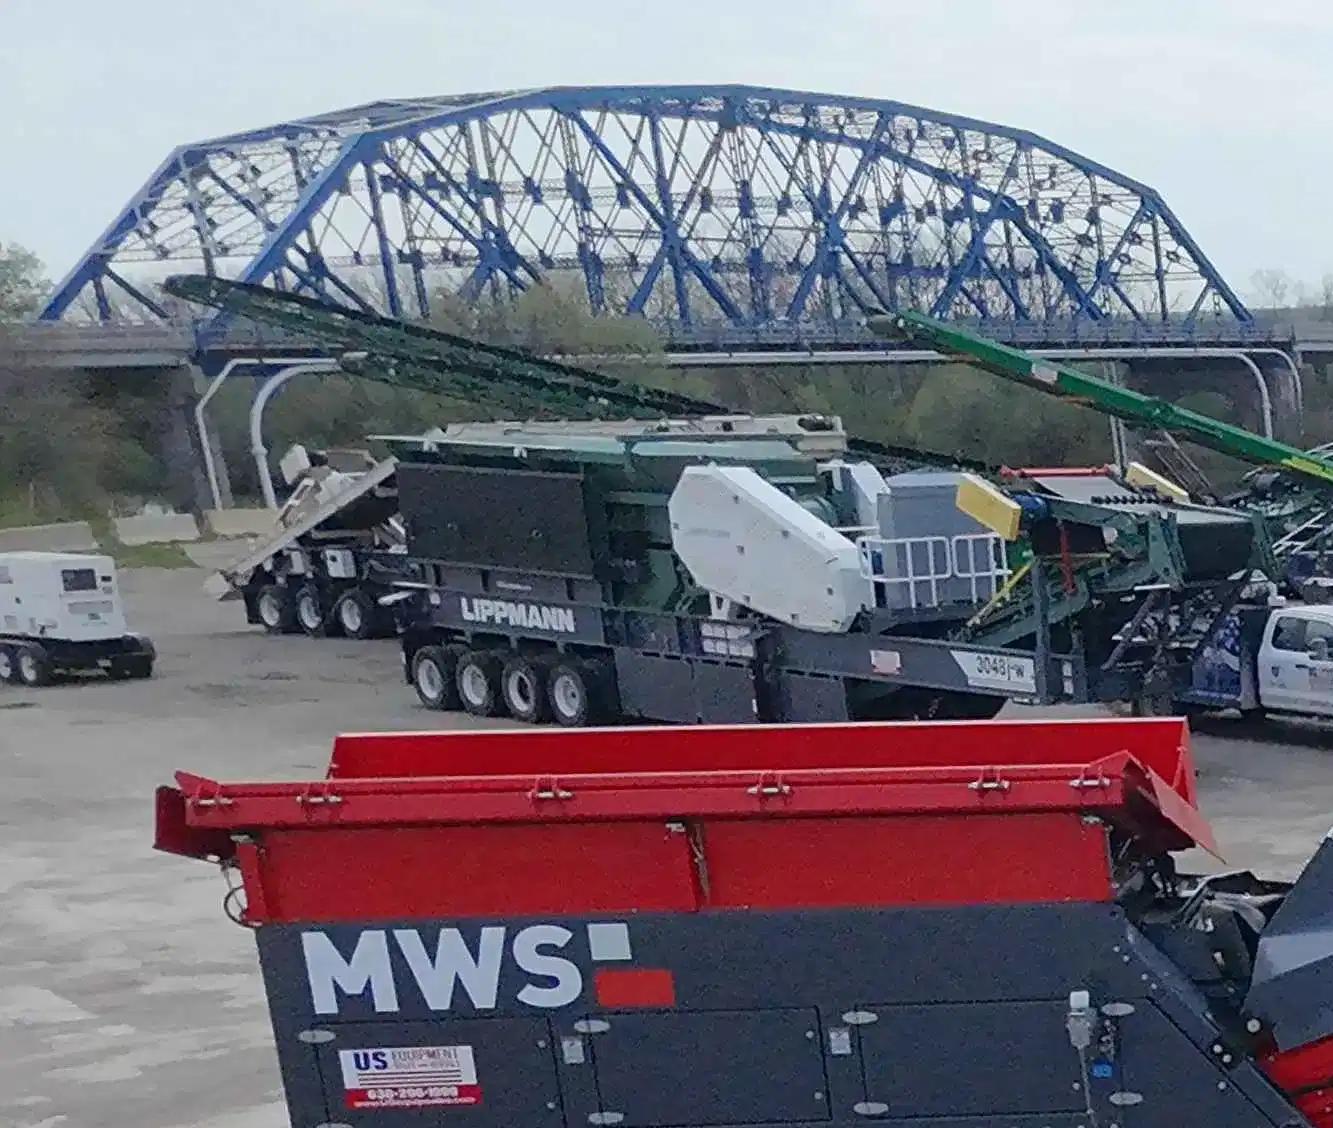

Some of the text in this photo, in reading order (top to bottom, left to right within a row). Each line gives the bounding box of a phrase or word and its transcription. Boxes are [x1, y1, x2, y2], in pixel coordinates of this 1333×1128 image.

[461, 597, 575, 633] LIPPMANN
[301, 924, 583, 1014] MWS
[353, 1051, 388, 1071] US
